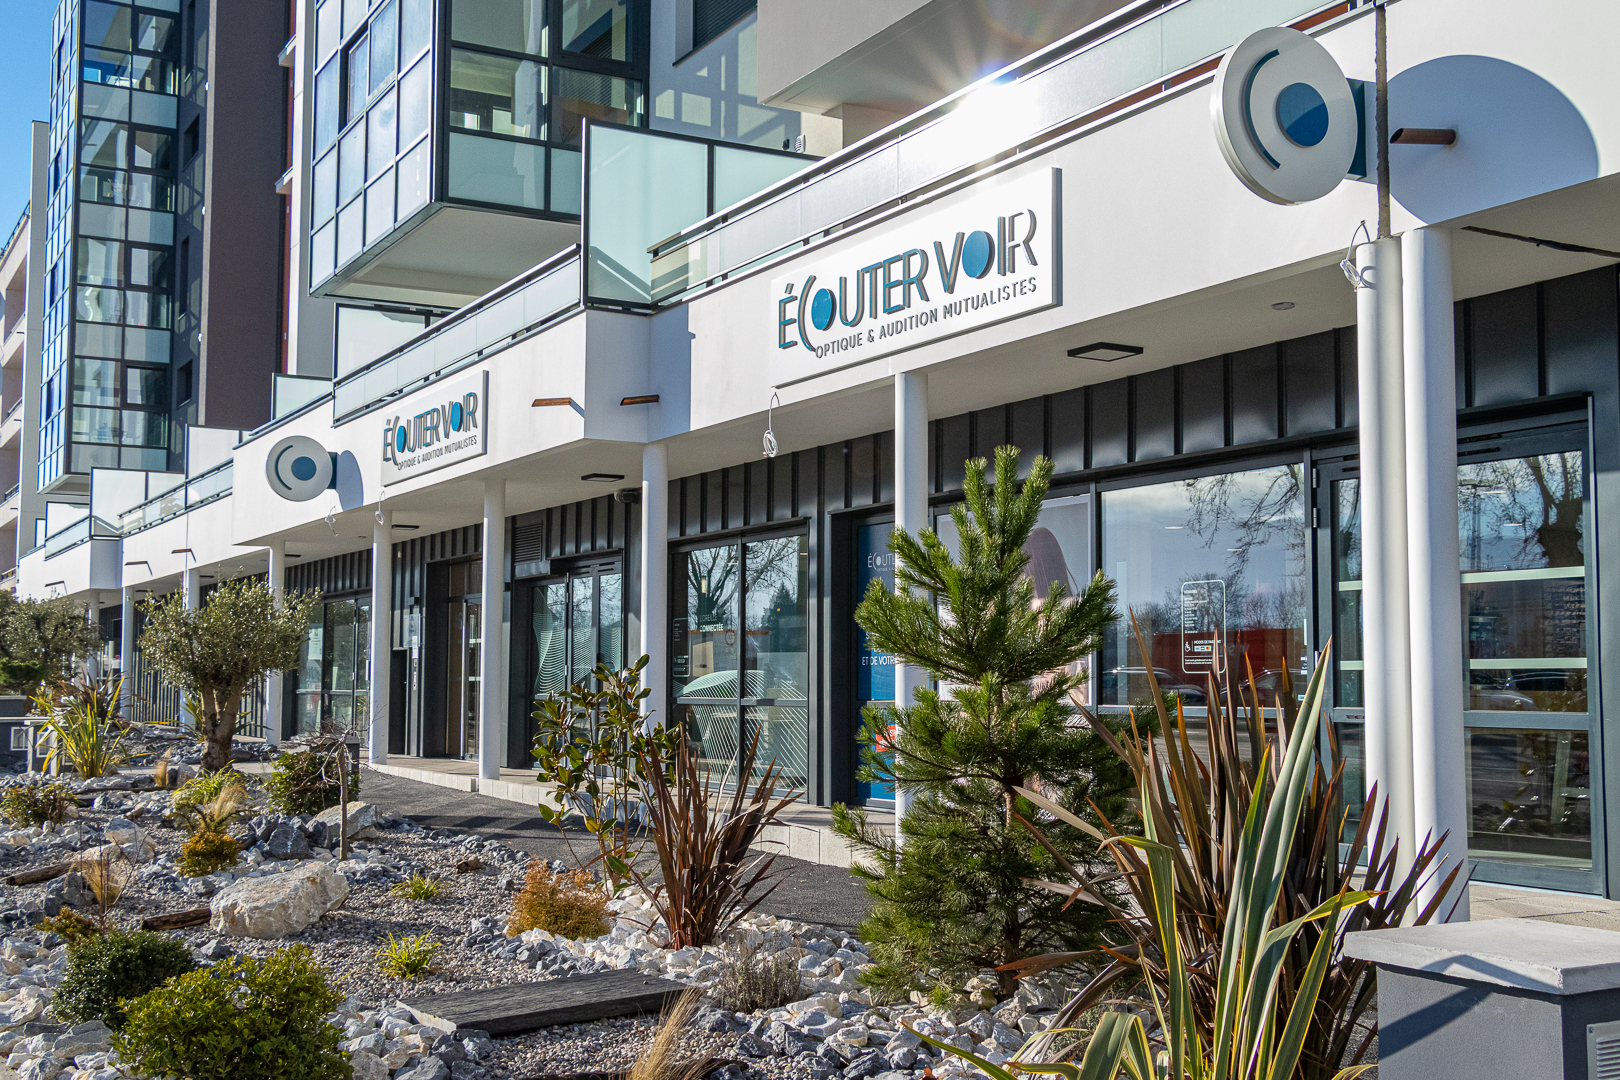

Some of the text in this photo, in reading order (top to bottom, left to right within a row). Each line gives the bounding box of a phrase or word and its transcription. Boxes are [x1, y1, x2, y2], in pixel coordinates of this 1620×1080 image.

[815, 276, 1037, 359] OPTIQUE & AUDITION MUTUALISTES
[397, 456, 417, 471] OPTIQUE
[421, 446, 444, 463] AUDITION
[444, 434, 478, 455] MUTUALISTES
[867, 552, 896, 570] ÉCOUTE
[699, 622, 724, 633] CONNECTÉE
[862, 655, 895, 666] ET DE VOTR
